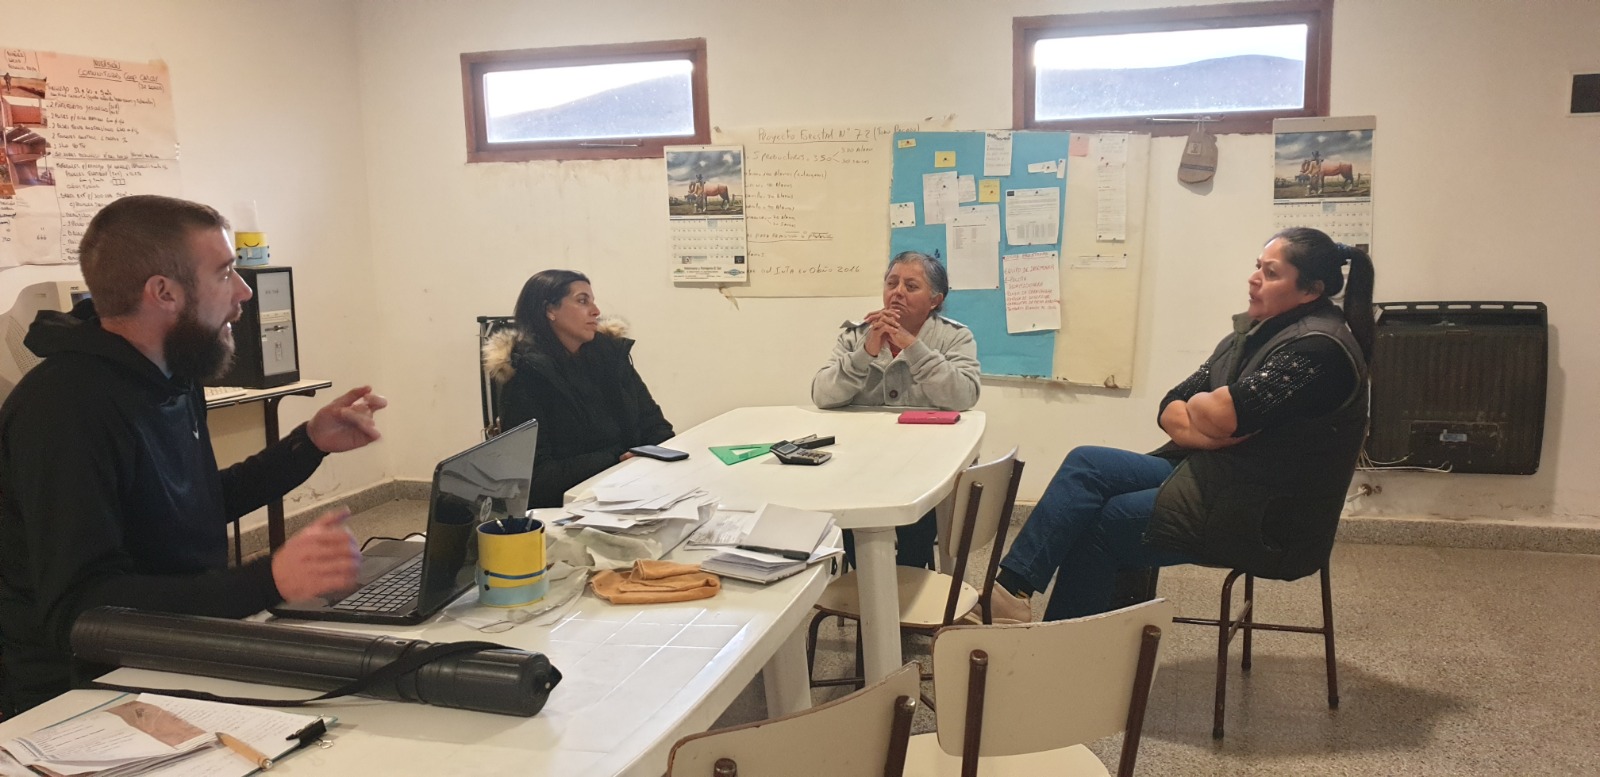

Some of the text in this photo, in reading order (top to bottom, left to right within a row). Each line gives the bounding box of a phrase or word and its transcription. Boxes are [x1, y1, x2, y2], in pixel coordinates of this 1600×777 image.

[757, 126, 796, 144] Proyecto
[799, 126, 834, 142] Forestal
[854, 127, 871, 141] 72
[836, 264, 861, 273] 2016
